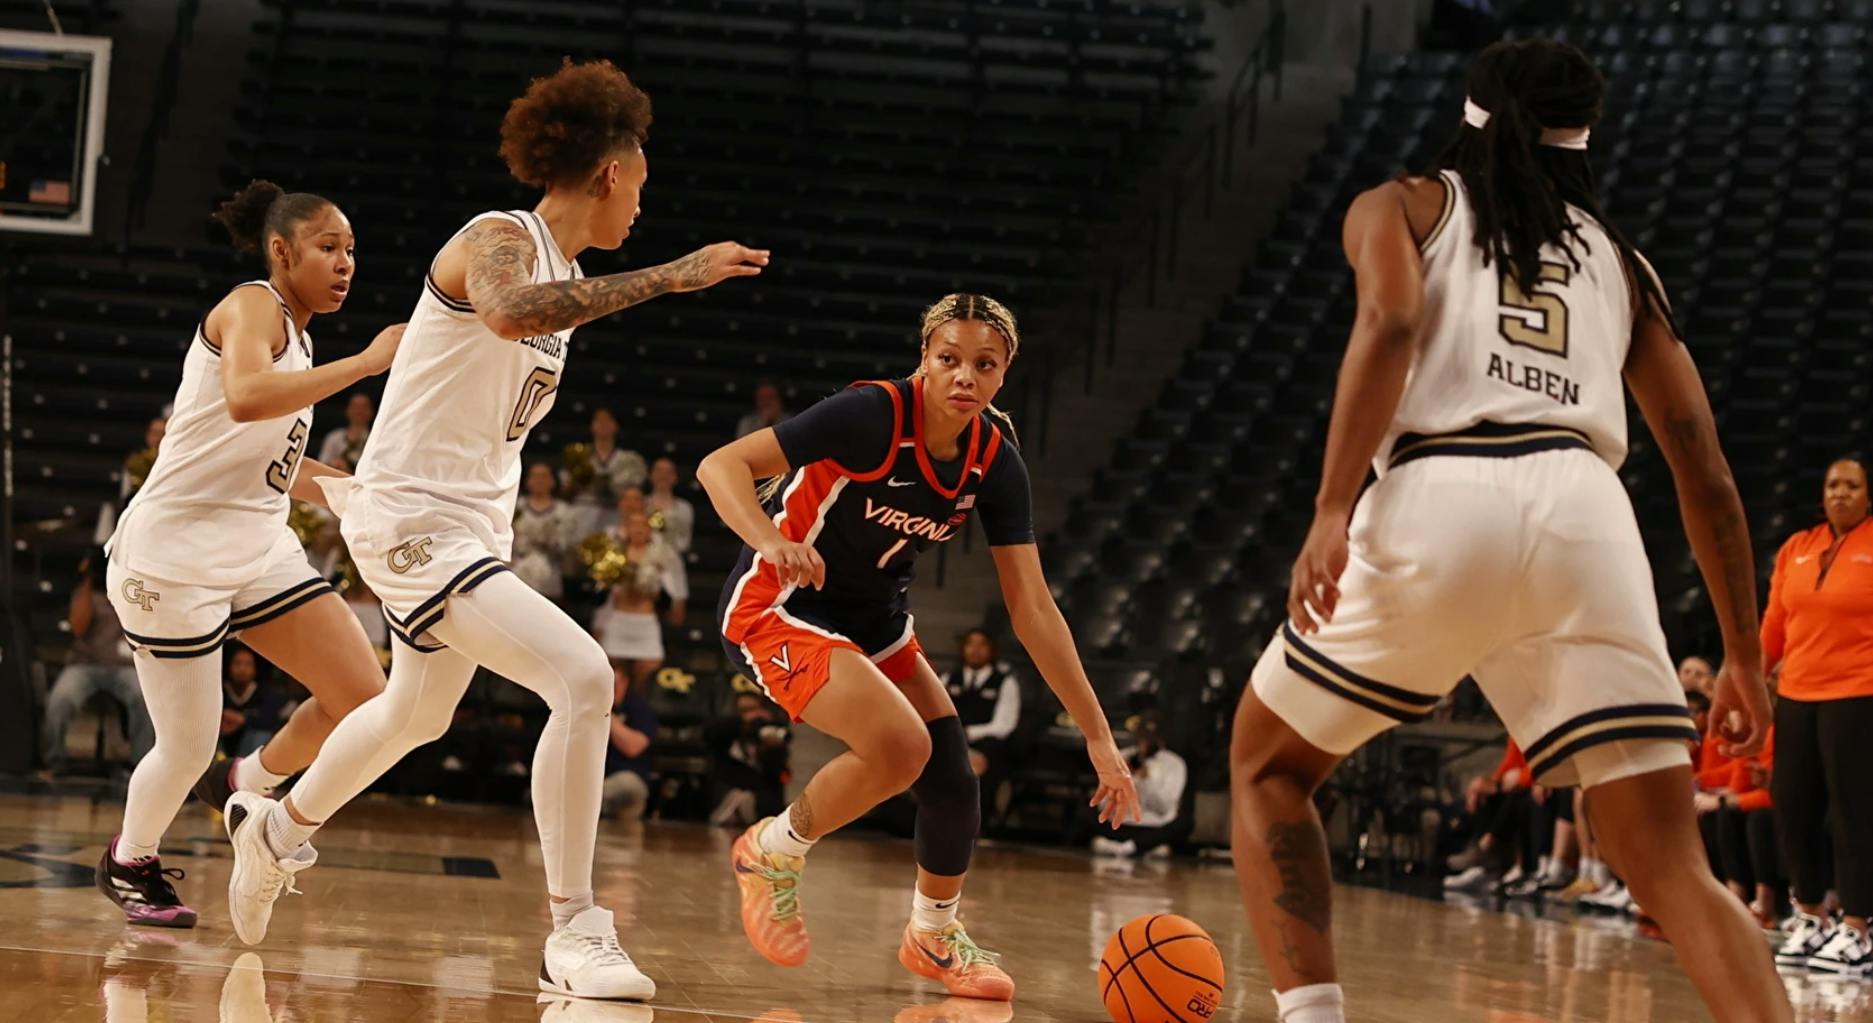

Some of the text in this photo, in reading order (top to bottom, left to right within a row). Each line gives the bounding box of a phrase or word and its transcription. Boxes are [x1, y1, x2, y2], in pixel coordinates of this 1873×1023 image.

[1498, 260, 1569, 360] 5
[511, 333, 563, 360] ORGIA
[1487, 352, 1580, 405] ALBEN
[505, 366, 558, 442] 0
[265, 417, 308, 495] 3
[864, 497, 959, 542] VIRGINI
[386, 536, 433, 574] GT
[876, 539, 908, 569] 1
[121, 577, 160, 612] GT
[770, 641, 791, 673] V
[1187, 998, 1214, 1019] PRO
